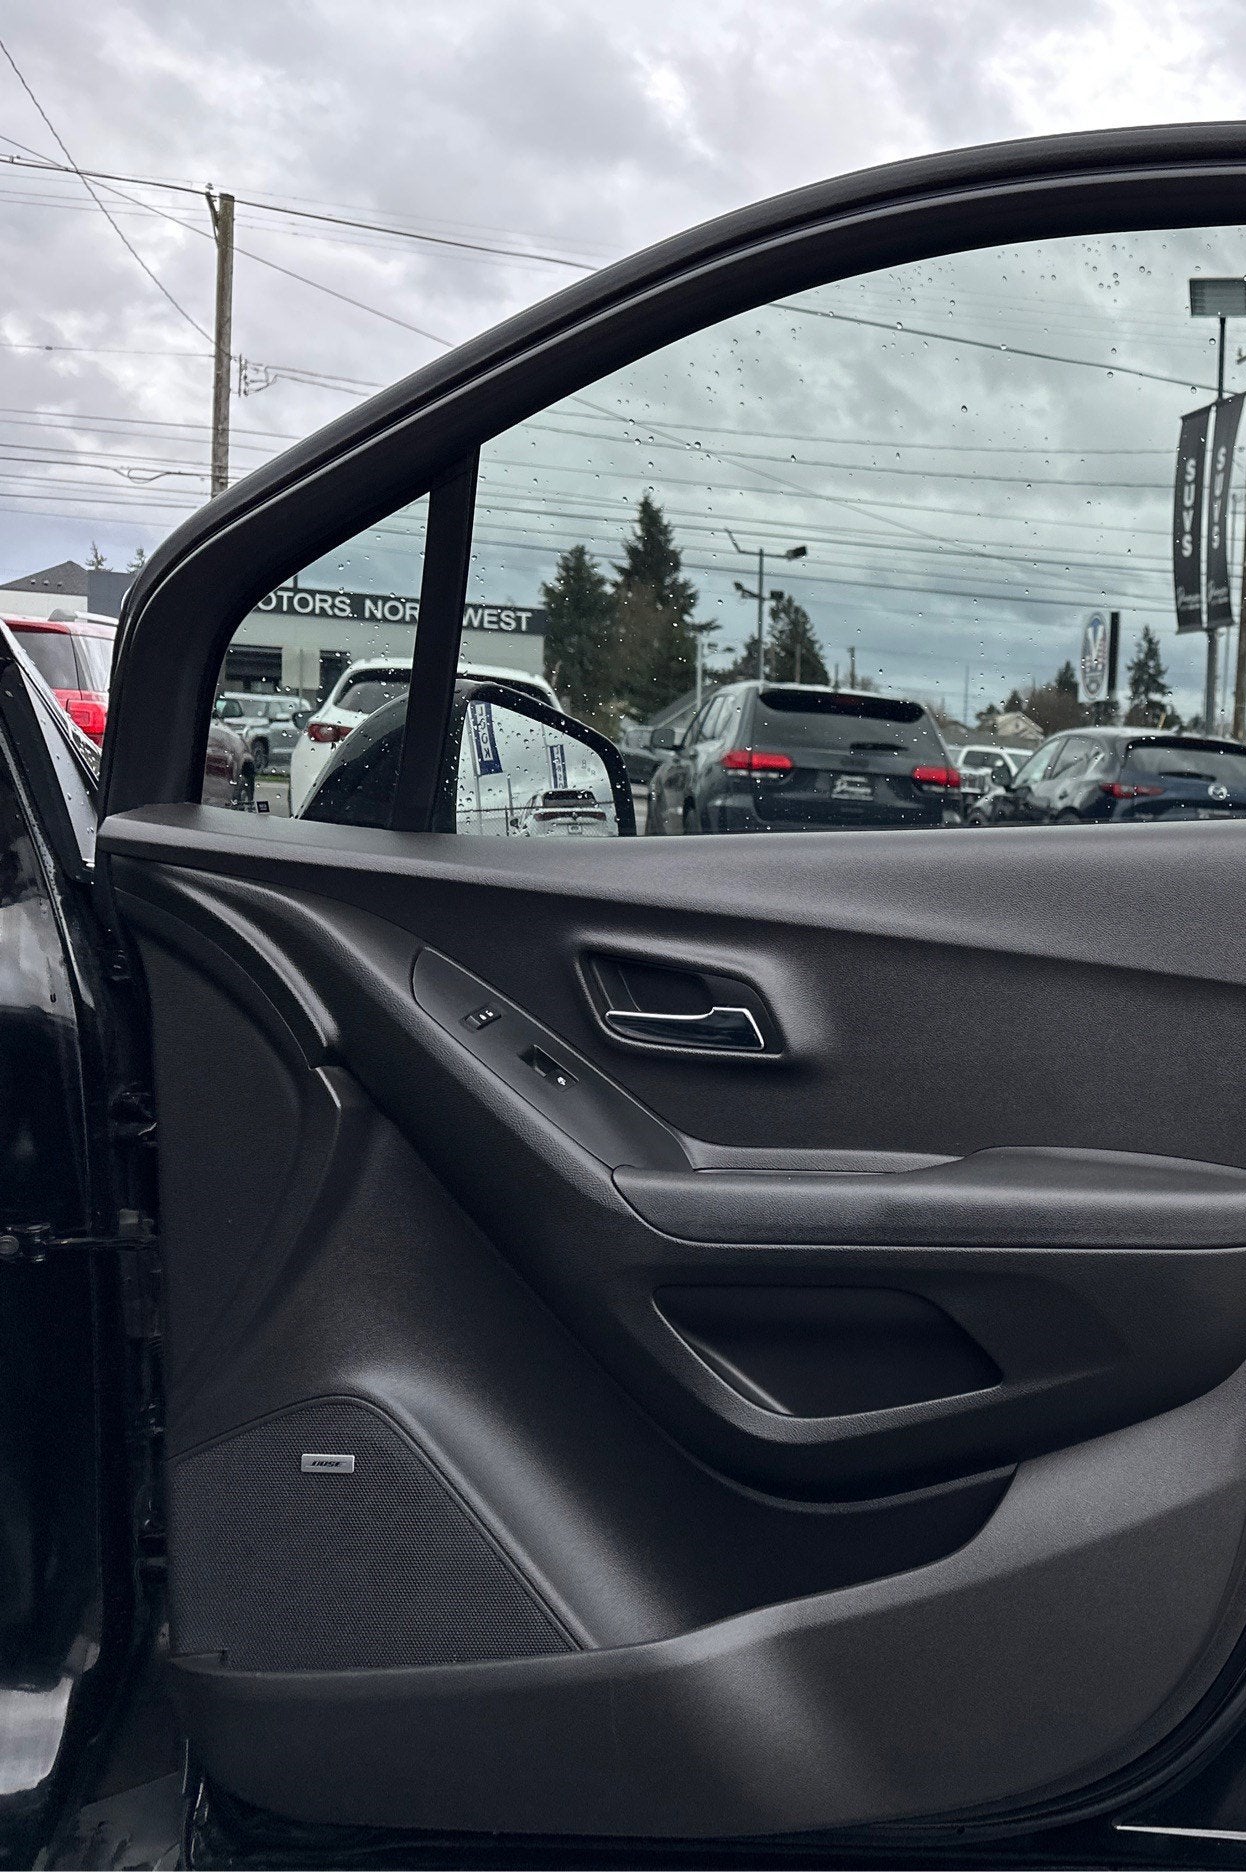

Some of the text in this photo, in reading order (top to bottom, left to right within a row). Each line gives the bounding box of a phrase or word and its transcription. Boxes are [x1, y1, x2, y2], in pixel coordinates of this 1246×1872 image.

[1182, 458, 1196, 557] SUVS
[257, 590, 533, 632] OTORS NORWEST
